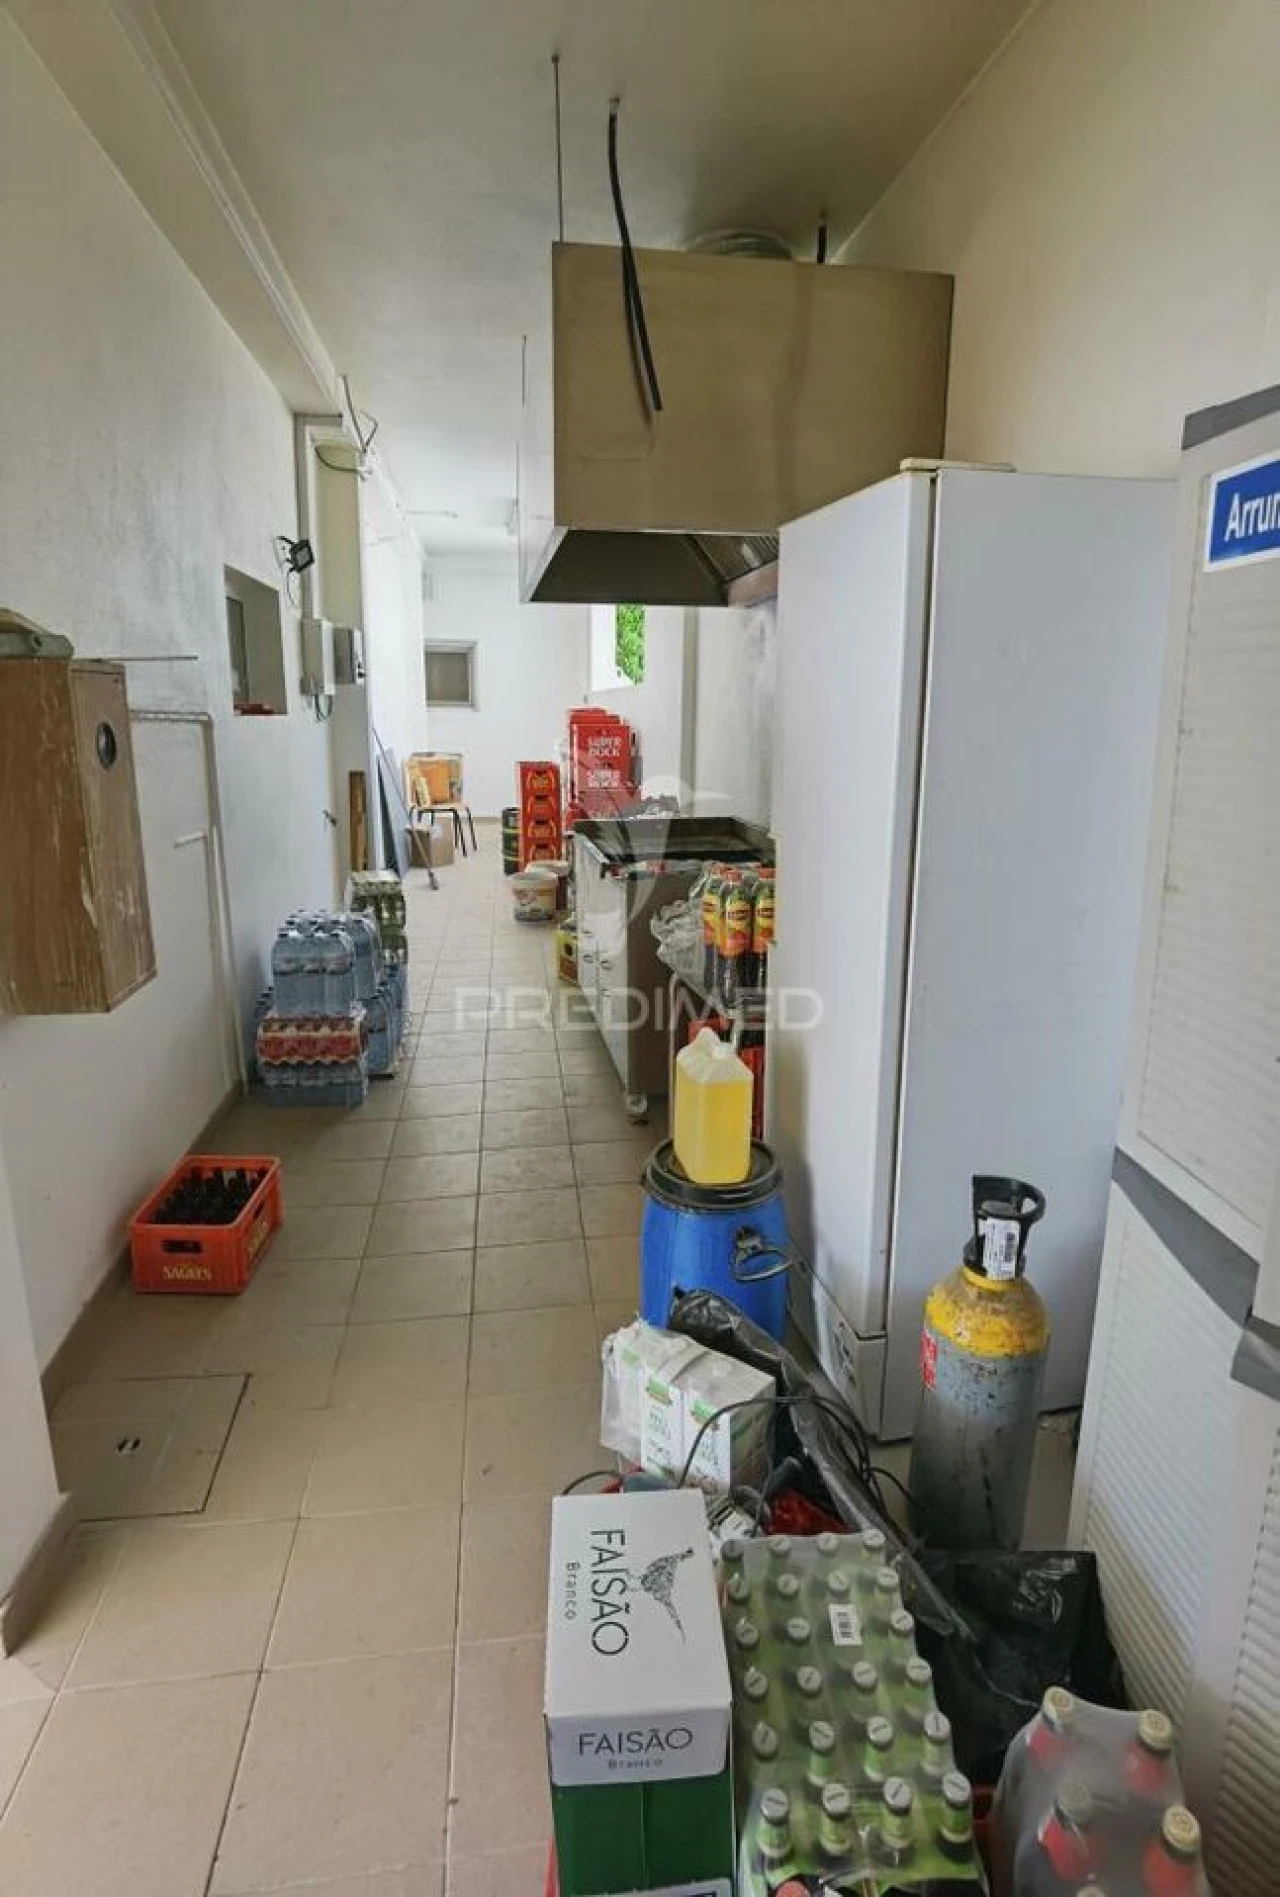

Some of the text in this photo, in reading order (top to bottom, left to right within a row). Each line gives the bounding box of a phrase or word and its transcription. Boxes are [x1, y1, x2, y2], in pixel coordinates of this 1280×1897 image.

[565, 1562, 581, 1620] Branco
[590, 1528, 630, 1656] FAISÃO
[578, 1726, 694, 1756] FAISÃO
